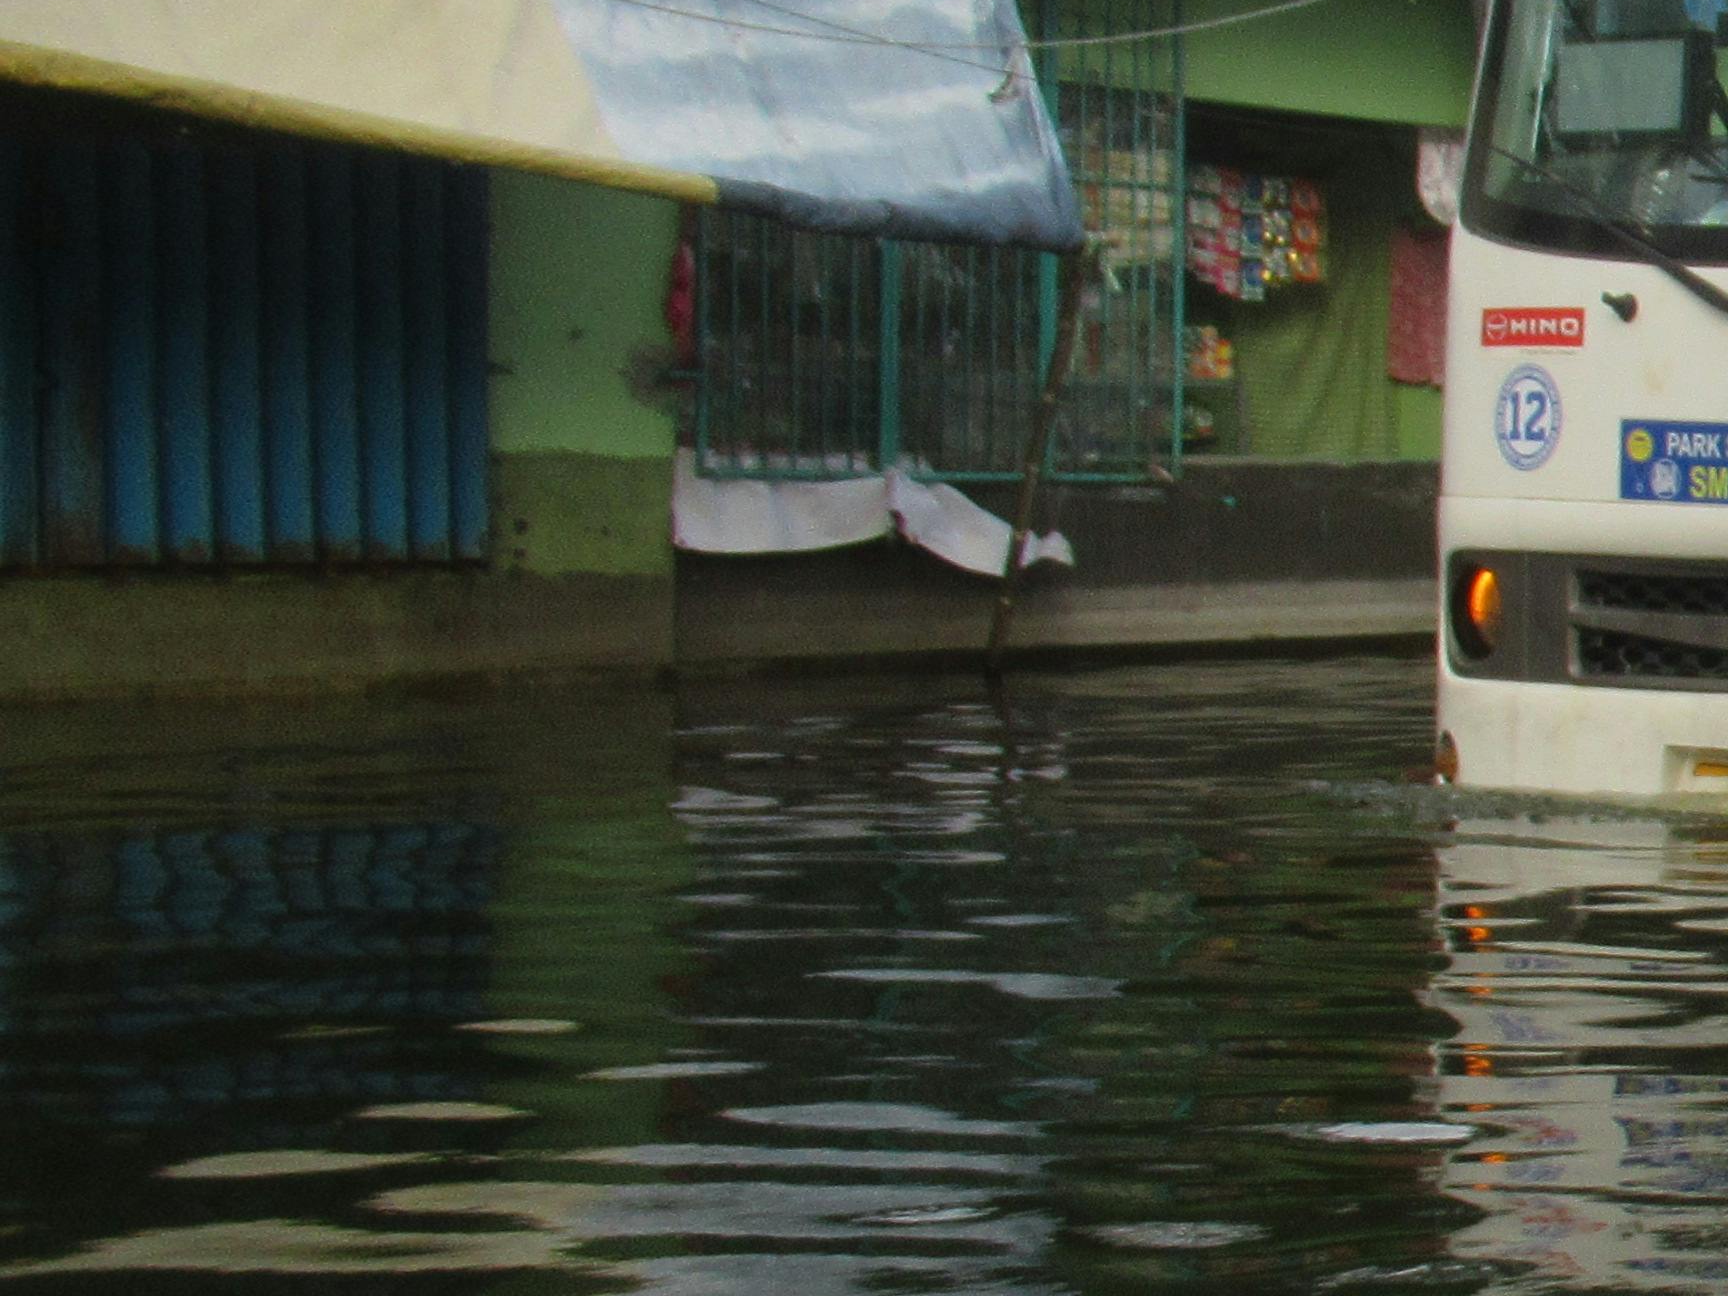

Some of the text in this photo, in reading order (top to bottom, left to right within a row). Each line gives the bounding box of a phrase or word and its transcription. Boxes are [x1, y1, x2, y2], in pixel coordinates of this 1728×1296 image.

[1511, 317, 1580, 337] HINO
[1509, 390, 1547, 441] 12
[1666, 431, 1721, 458] PARK
